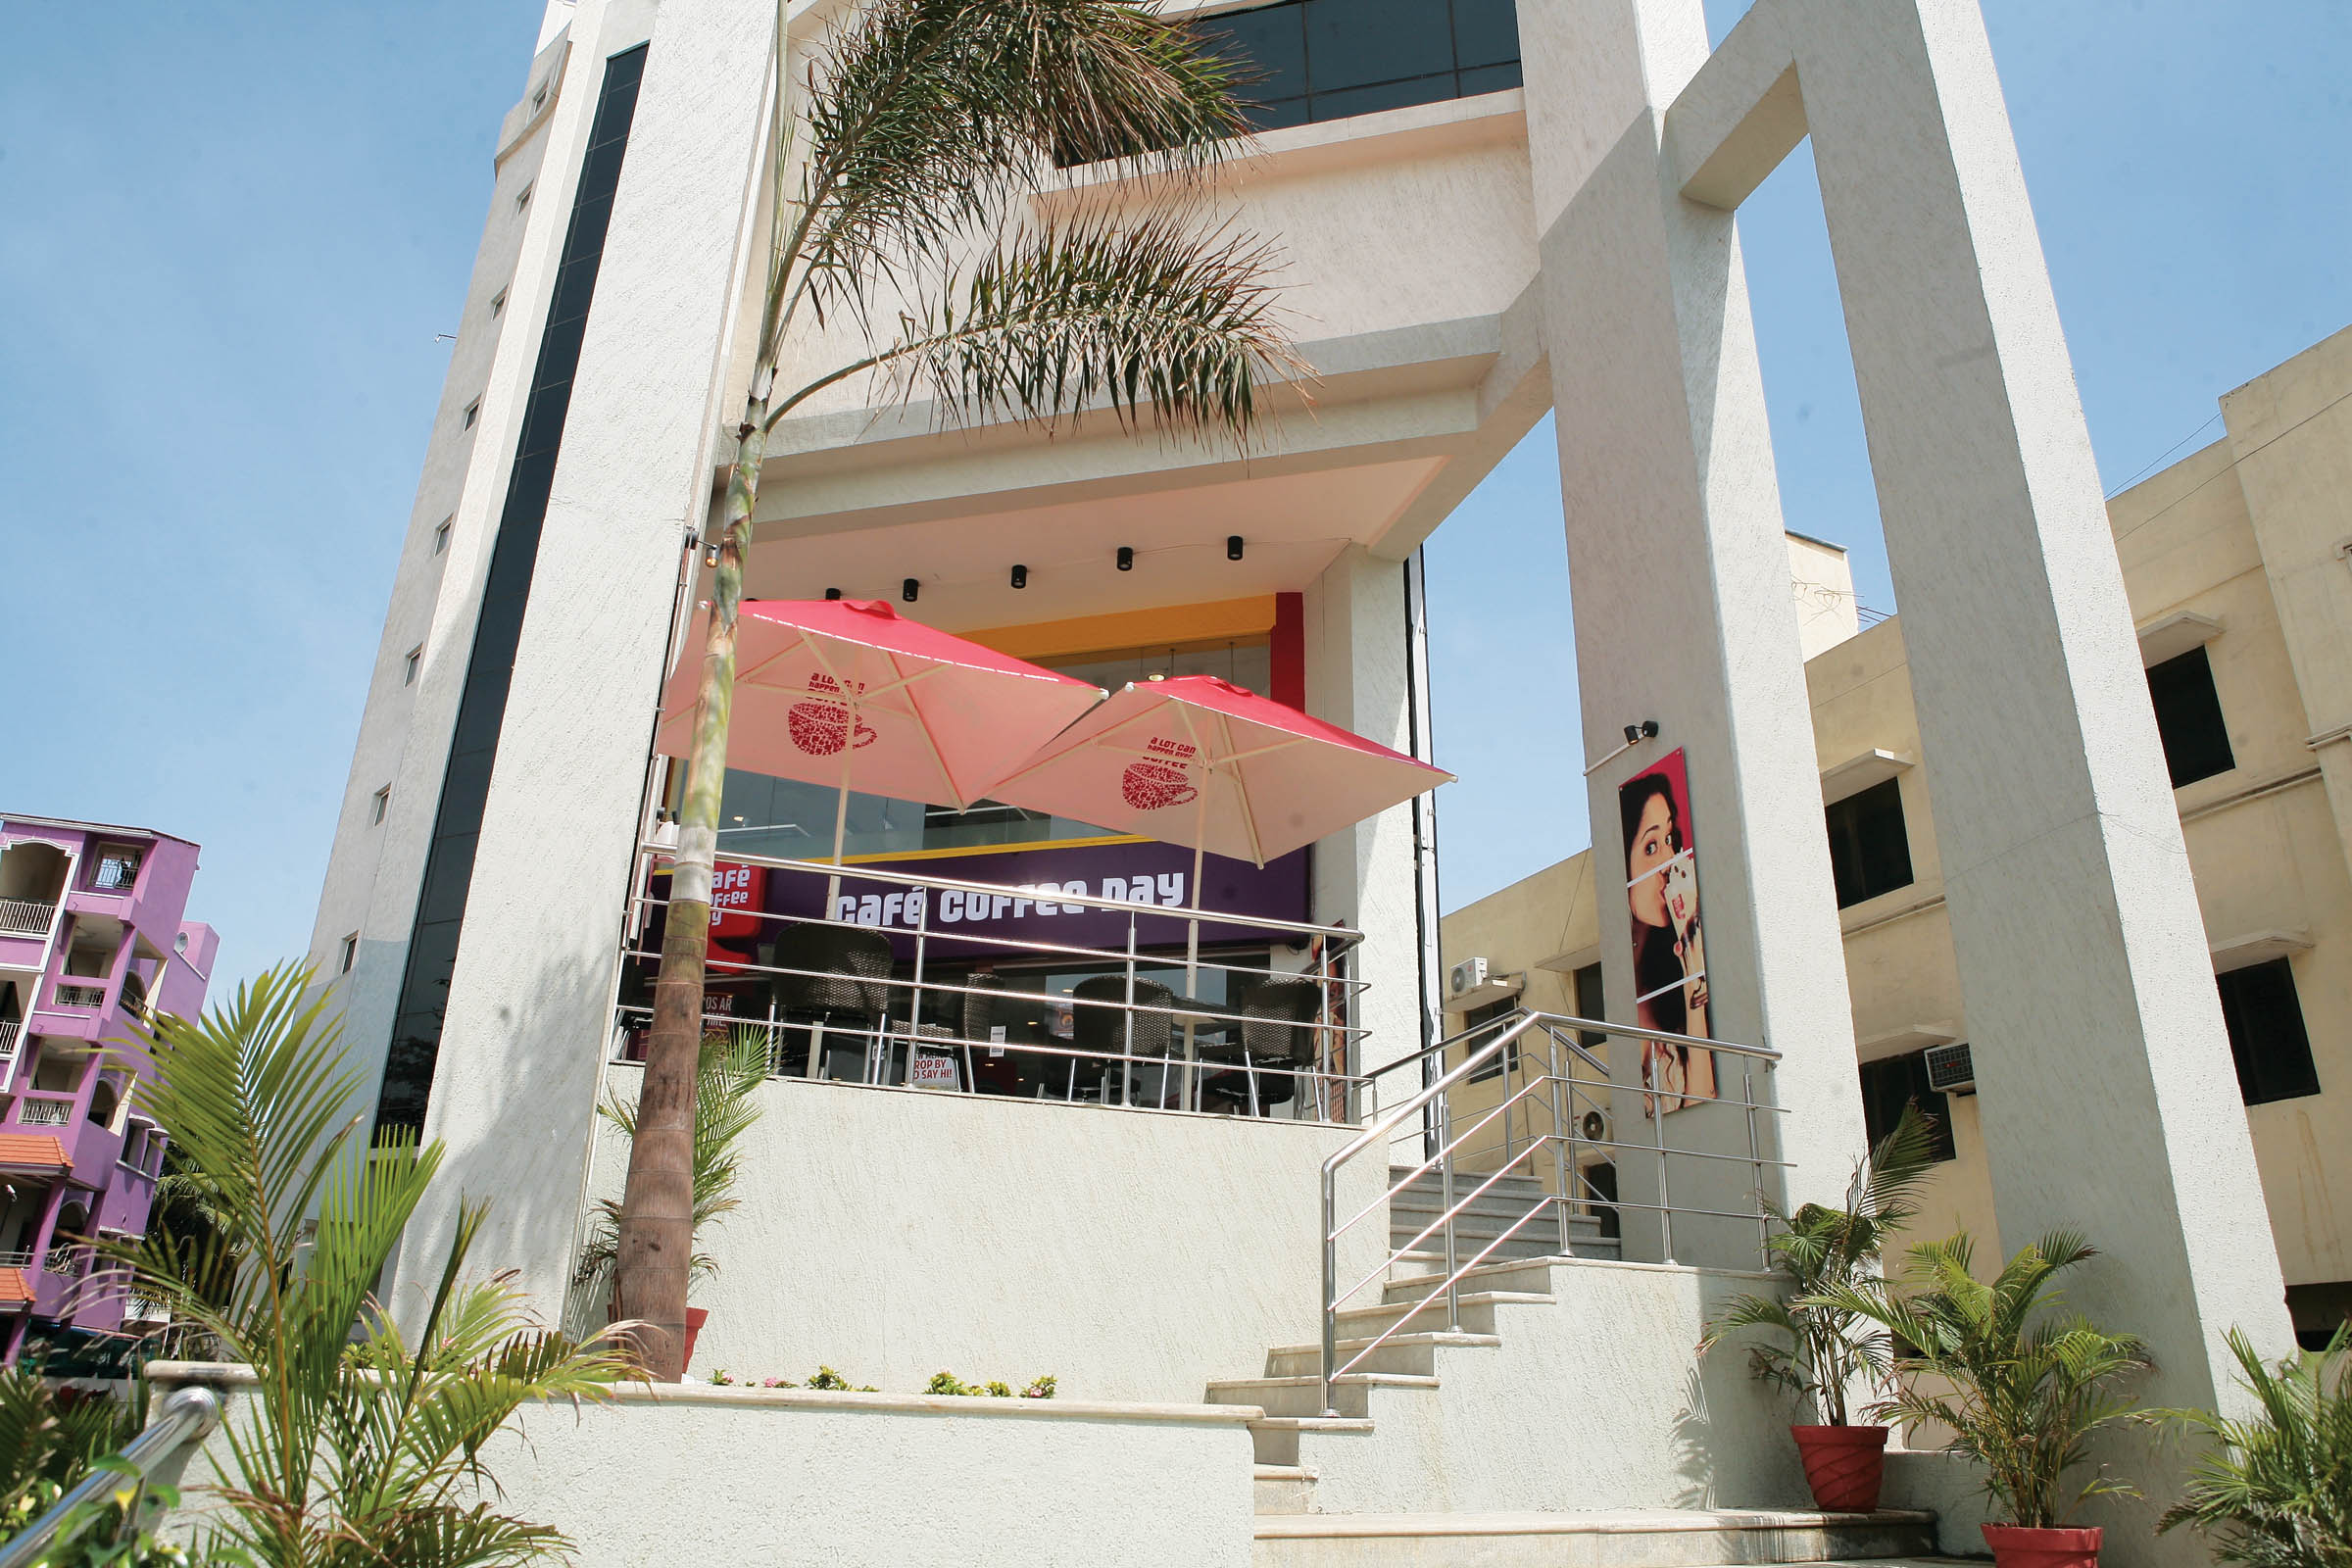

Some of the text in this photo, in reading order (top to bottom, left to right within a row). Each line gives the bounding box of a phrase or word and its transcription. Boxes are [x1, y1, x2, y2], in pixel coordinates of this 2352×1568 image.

[822, 674, 837, 685] LO
[1159, 739, 1177, 749] LOT
[935, 1059, 946, 1068] BY
[922, 1069, 938, 1079] SAY
[941, 1069, 952, 1078] HI!
